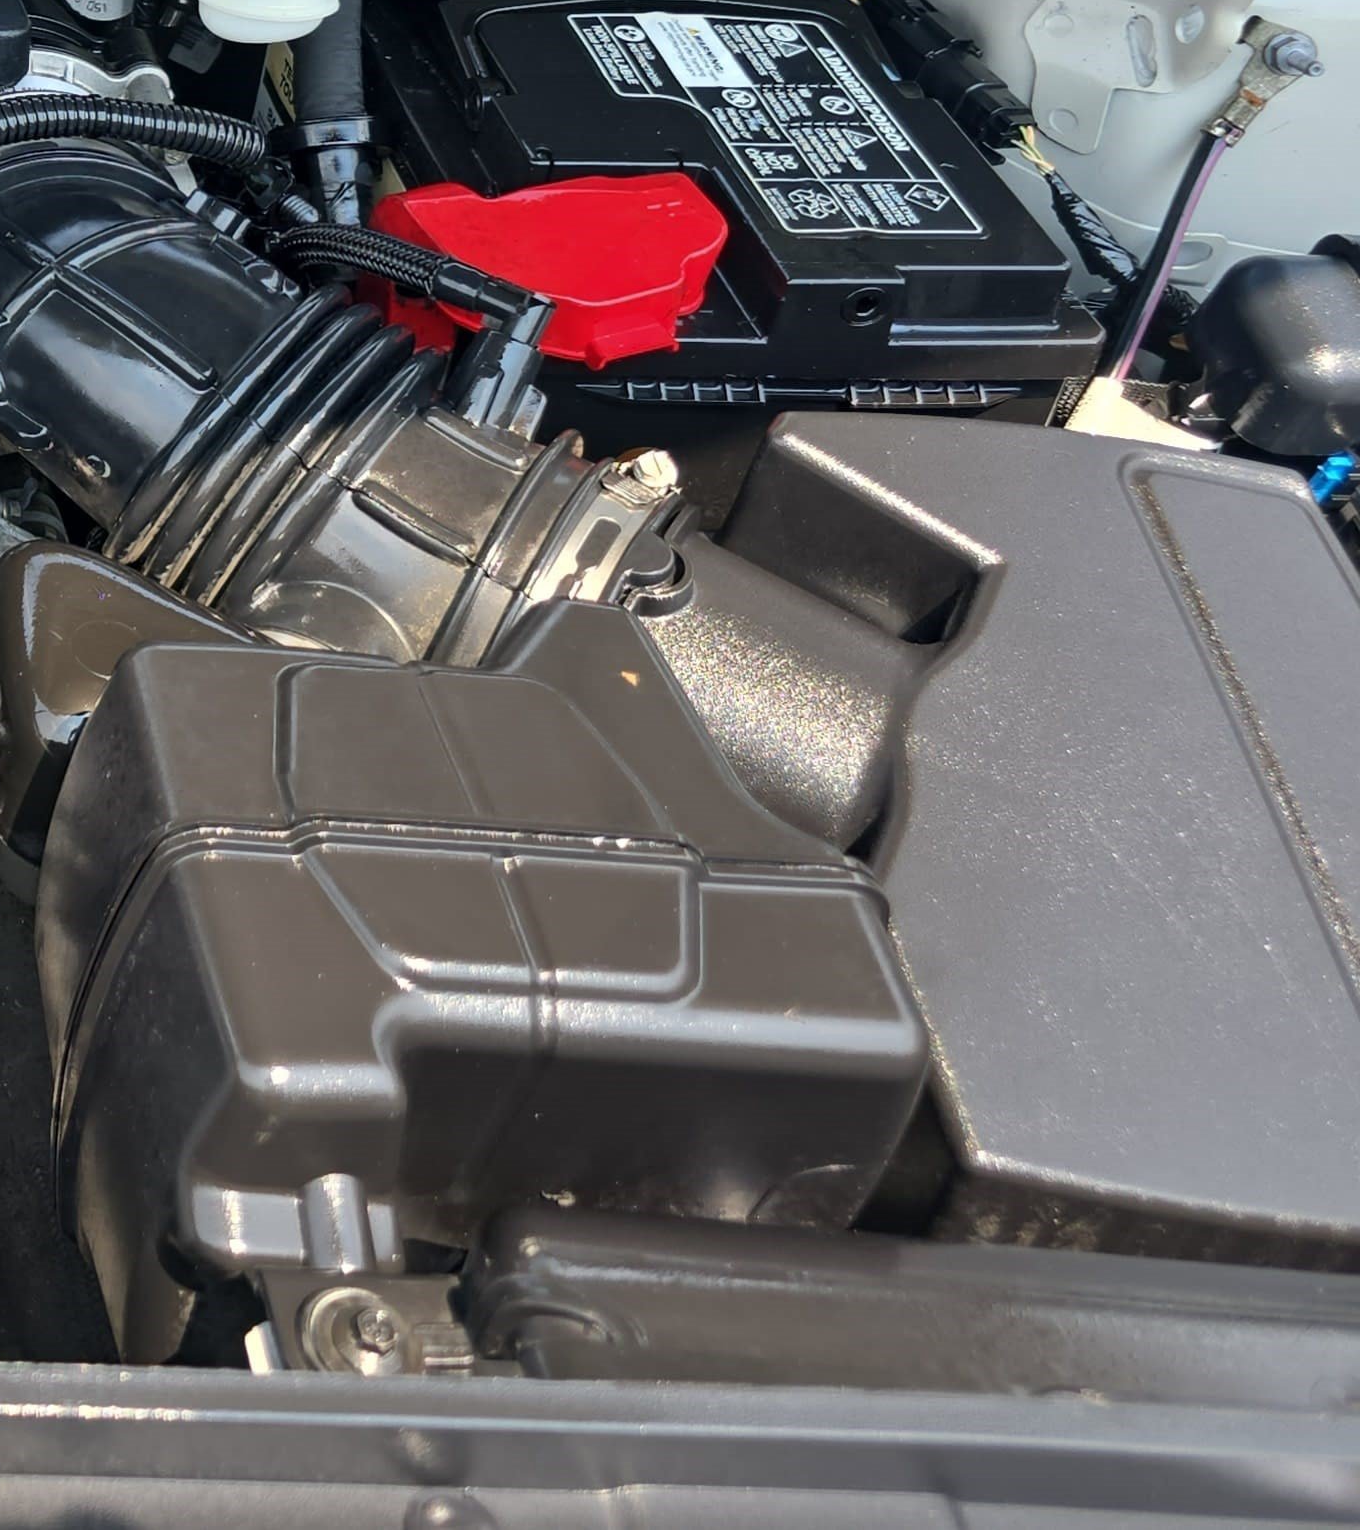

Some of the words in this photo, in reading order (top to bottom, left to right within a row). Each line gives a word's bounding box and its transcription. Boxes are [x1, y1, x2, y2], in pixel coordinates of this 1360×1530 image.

[826, 53, 911, 153] DANGER/POISON
[761, 151, 786, 172] NOT
[778, 154, 799, 170] DO
